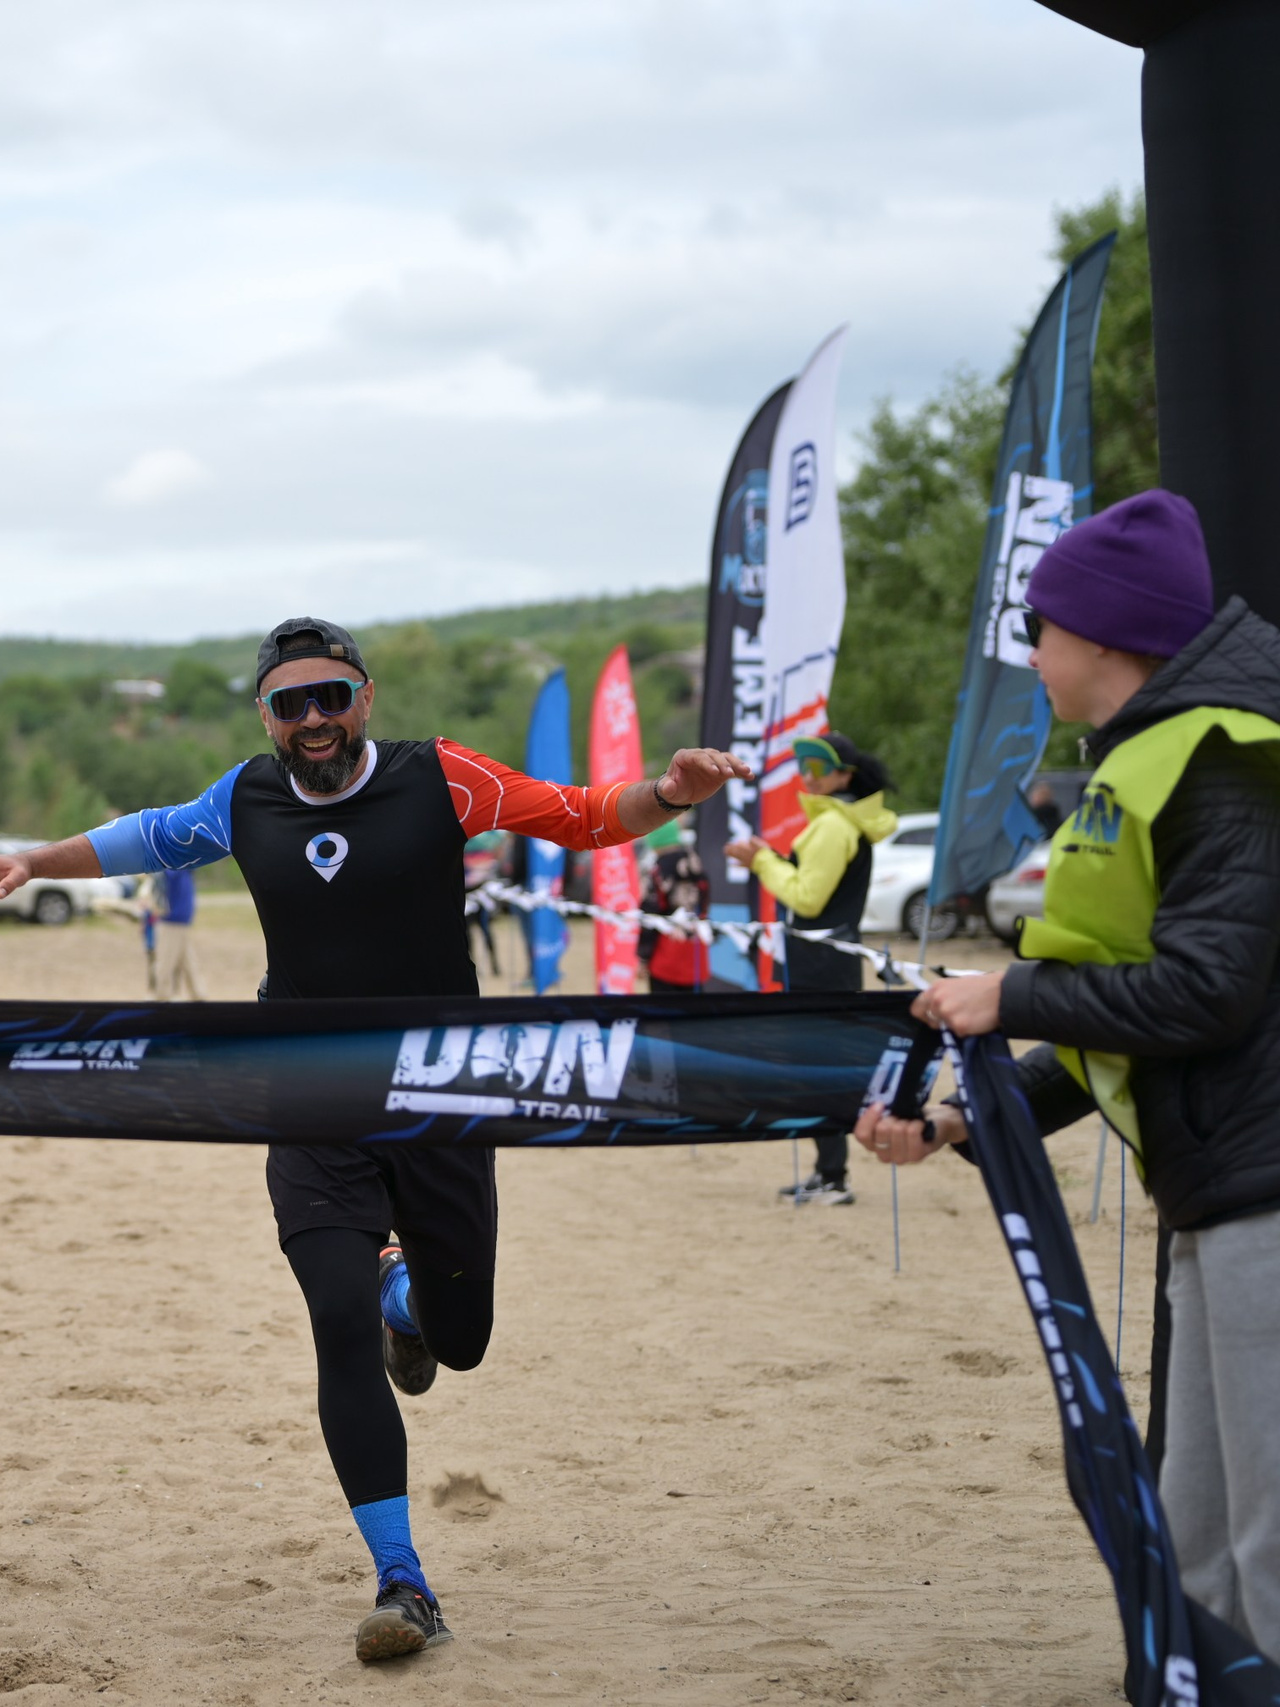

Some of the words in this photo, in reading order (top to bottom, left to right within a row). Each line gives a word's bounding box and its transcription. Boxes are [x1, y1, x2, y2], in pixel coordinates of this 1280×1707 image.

[85, 1060, 140, 1071] TRAIL
[392, 1017, 639, 1101] DON
[519, 1099, 610, 1122] TRAIL
